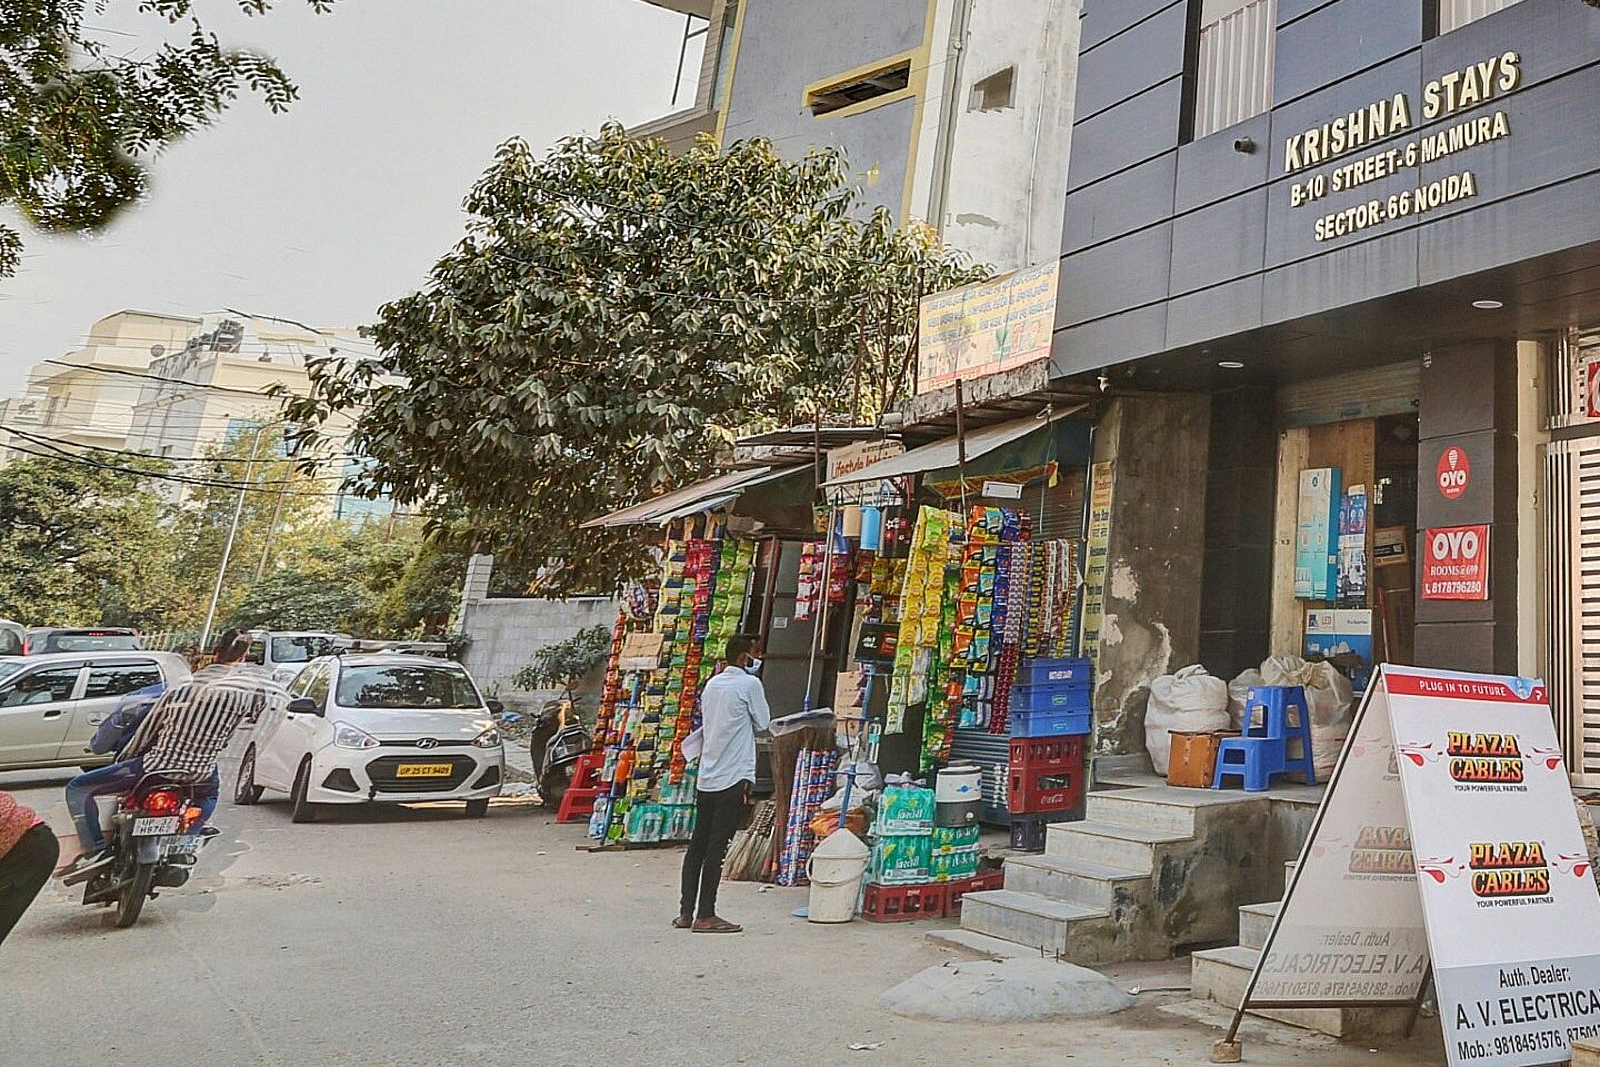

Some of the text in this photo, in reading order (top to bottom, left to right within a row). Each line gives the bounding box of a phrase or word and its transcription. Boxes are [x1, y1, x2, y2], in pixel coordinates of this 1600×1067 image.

[1284, 51, 1519, 173] KRISHNA STAYS
[1290, 174, 1327, 208] B-10
[1421, 111, 1510, 163] MAMURA
[1315, 171, 1476, 242] SECTOR-66 NOIDA
[1440, 470, 1467, 487] OYO
[1432, 531, 1478, 560] OYO
[1420, 680, 1506, 696] PLUG IN TO FUTURE
[1447, 731, 1520, 757] PLAZA
[1450, 758, 1524, 782] CABLES
[1503, 785, 1527, 793] PARTNER
[1469, 842, 1547, 869] PLAZA
[1472, 869, 1549, 897] CABLES
[1477, 900, 1493, 908] YOUR
[1495, 899, 1526, 907] POWERFUL
[1500, 964, 1571, 988] Auth. Dealer:
[1456, 1003, 1475, 1030] A.
[1477, 1001, 1496, 1026] V.
[1458, 1039, 1492, 1060] Mob.:
